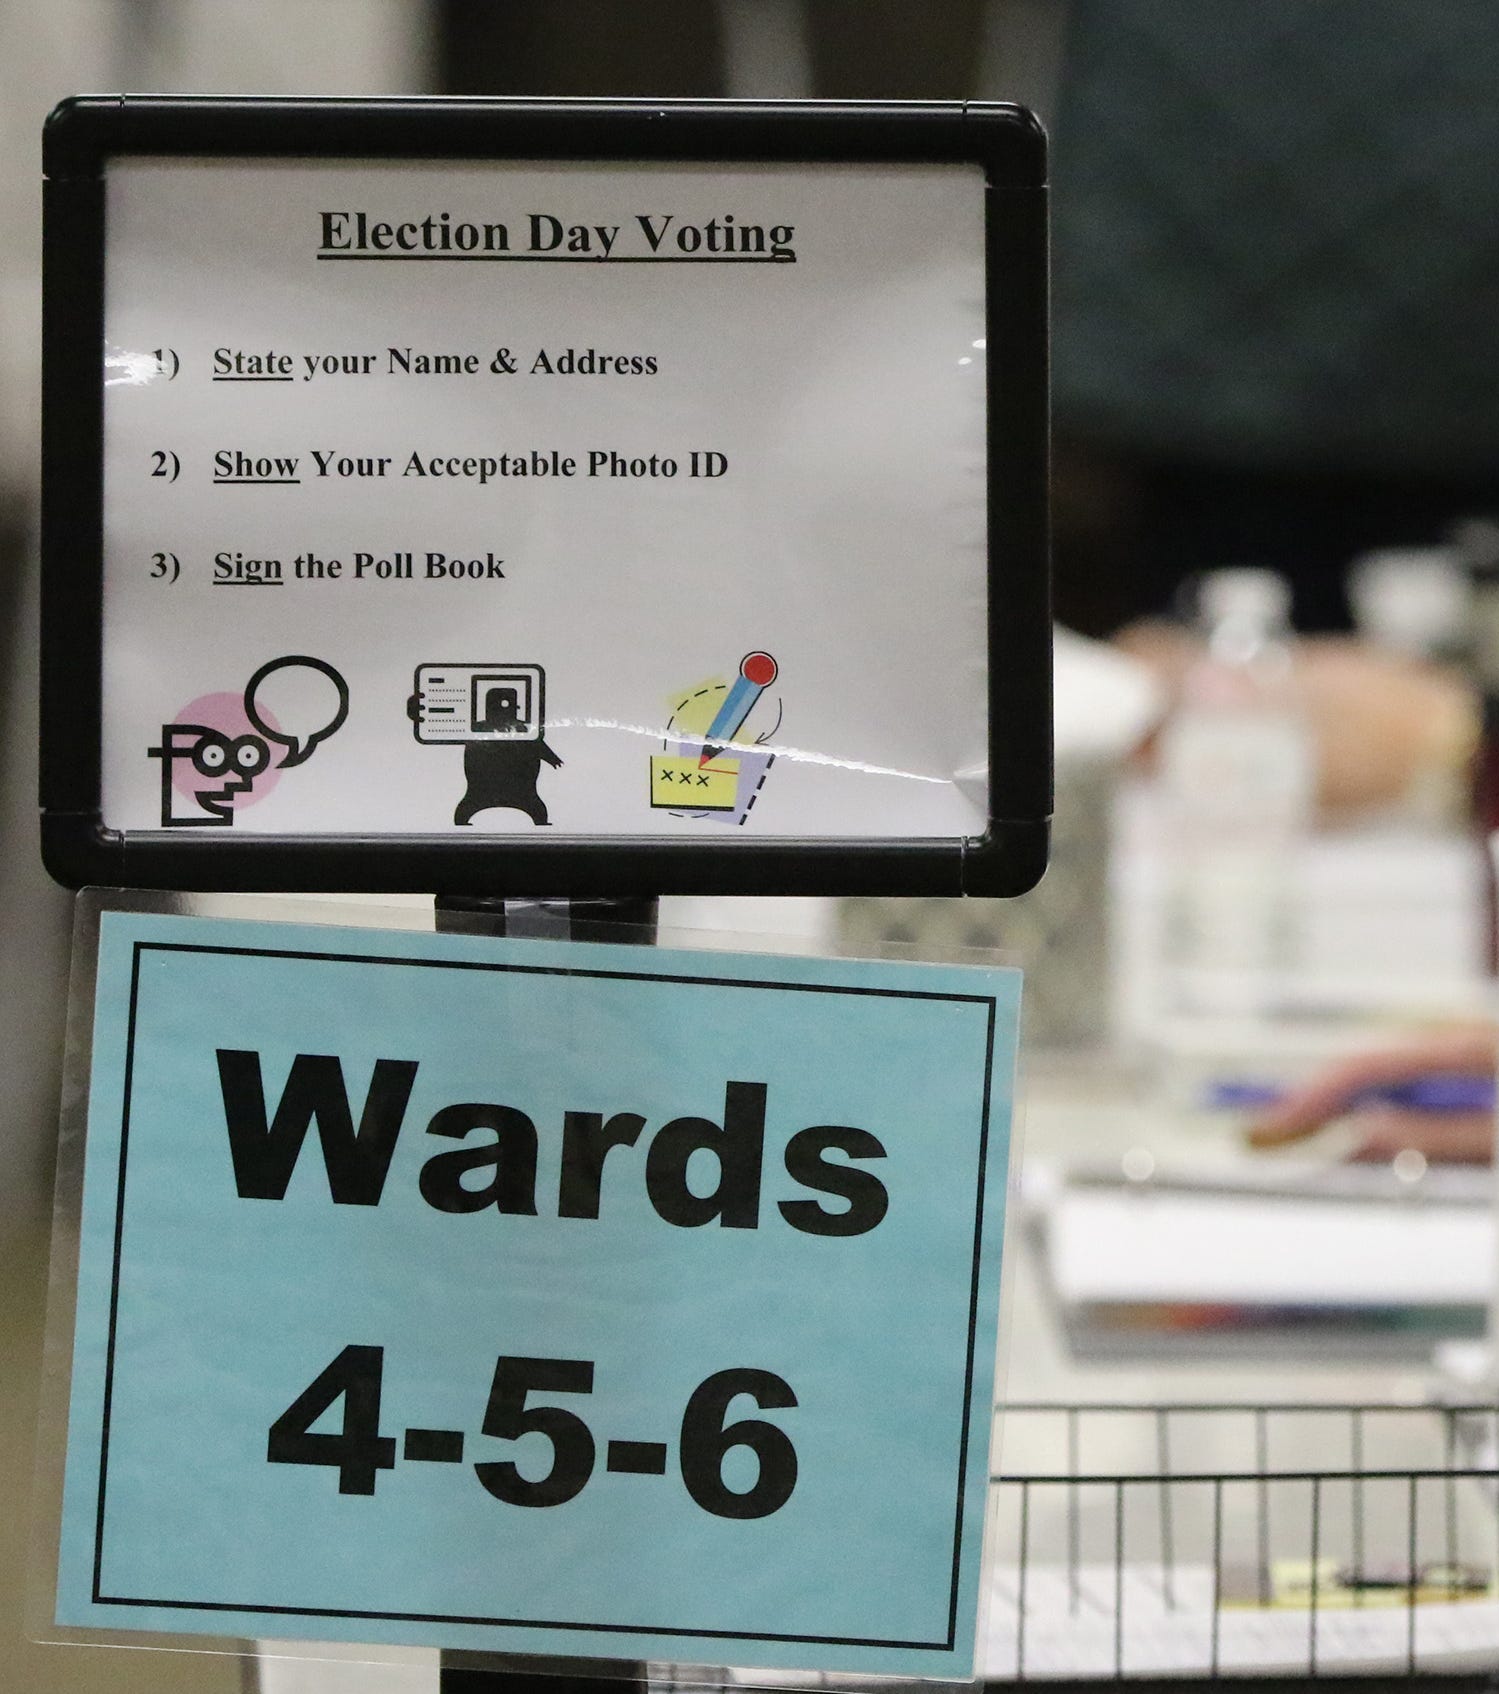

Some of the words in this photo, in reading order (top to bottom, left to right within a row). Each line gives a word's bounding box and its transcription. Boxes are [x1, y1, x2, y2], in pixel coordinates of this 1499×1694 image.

[317, 211, 511, 252] Election
[525, 212, 621, 259] Day
[634, 213, 797, 262] Voting
[213, 348, 294, 375] State
[303, 355, 377, 382] your
[387, 347, 480, 375] Name
[489, 347, 519, 375] &
[529, 348, 658, 376] Address
[151, 450, 181, 483] 2)
[213, 450, 301, 477] Show
[310, 450, 392, 477] Your
[402, 450, 577, 485] Acceptable
[587, 451, 678, 478] Photo
[689, 451, 729, 478] ID
[149, 552, 181, 585] 3)
[213, 552, 285, 586] Sign
[293, 552, 343, 579] the
[353, 552, 413, 580] Poll
[423, 552, 506, 579] Book
[216, 1049, 889, 1238] Wards
[266, 1344, 799, 1520] 4-5-6
